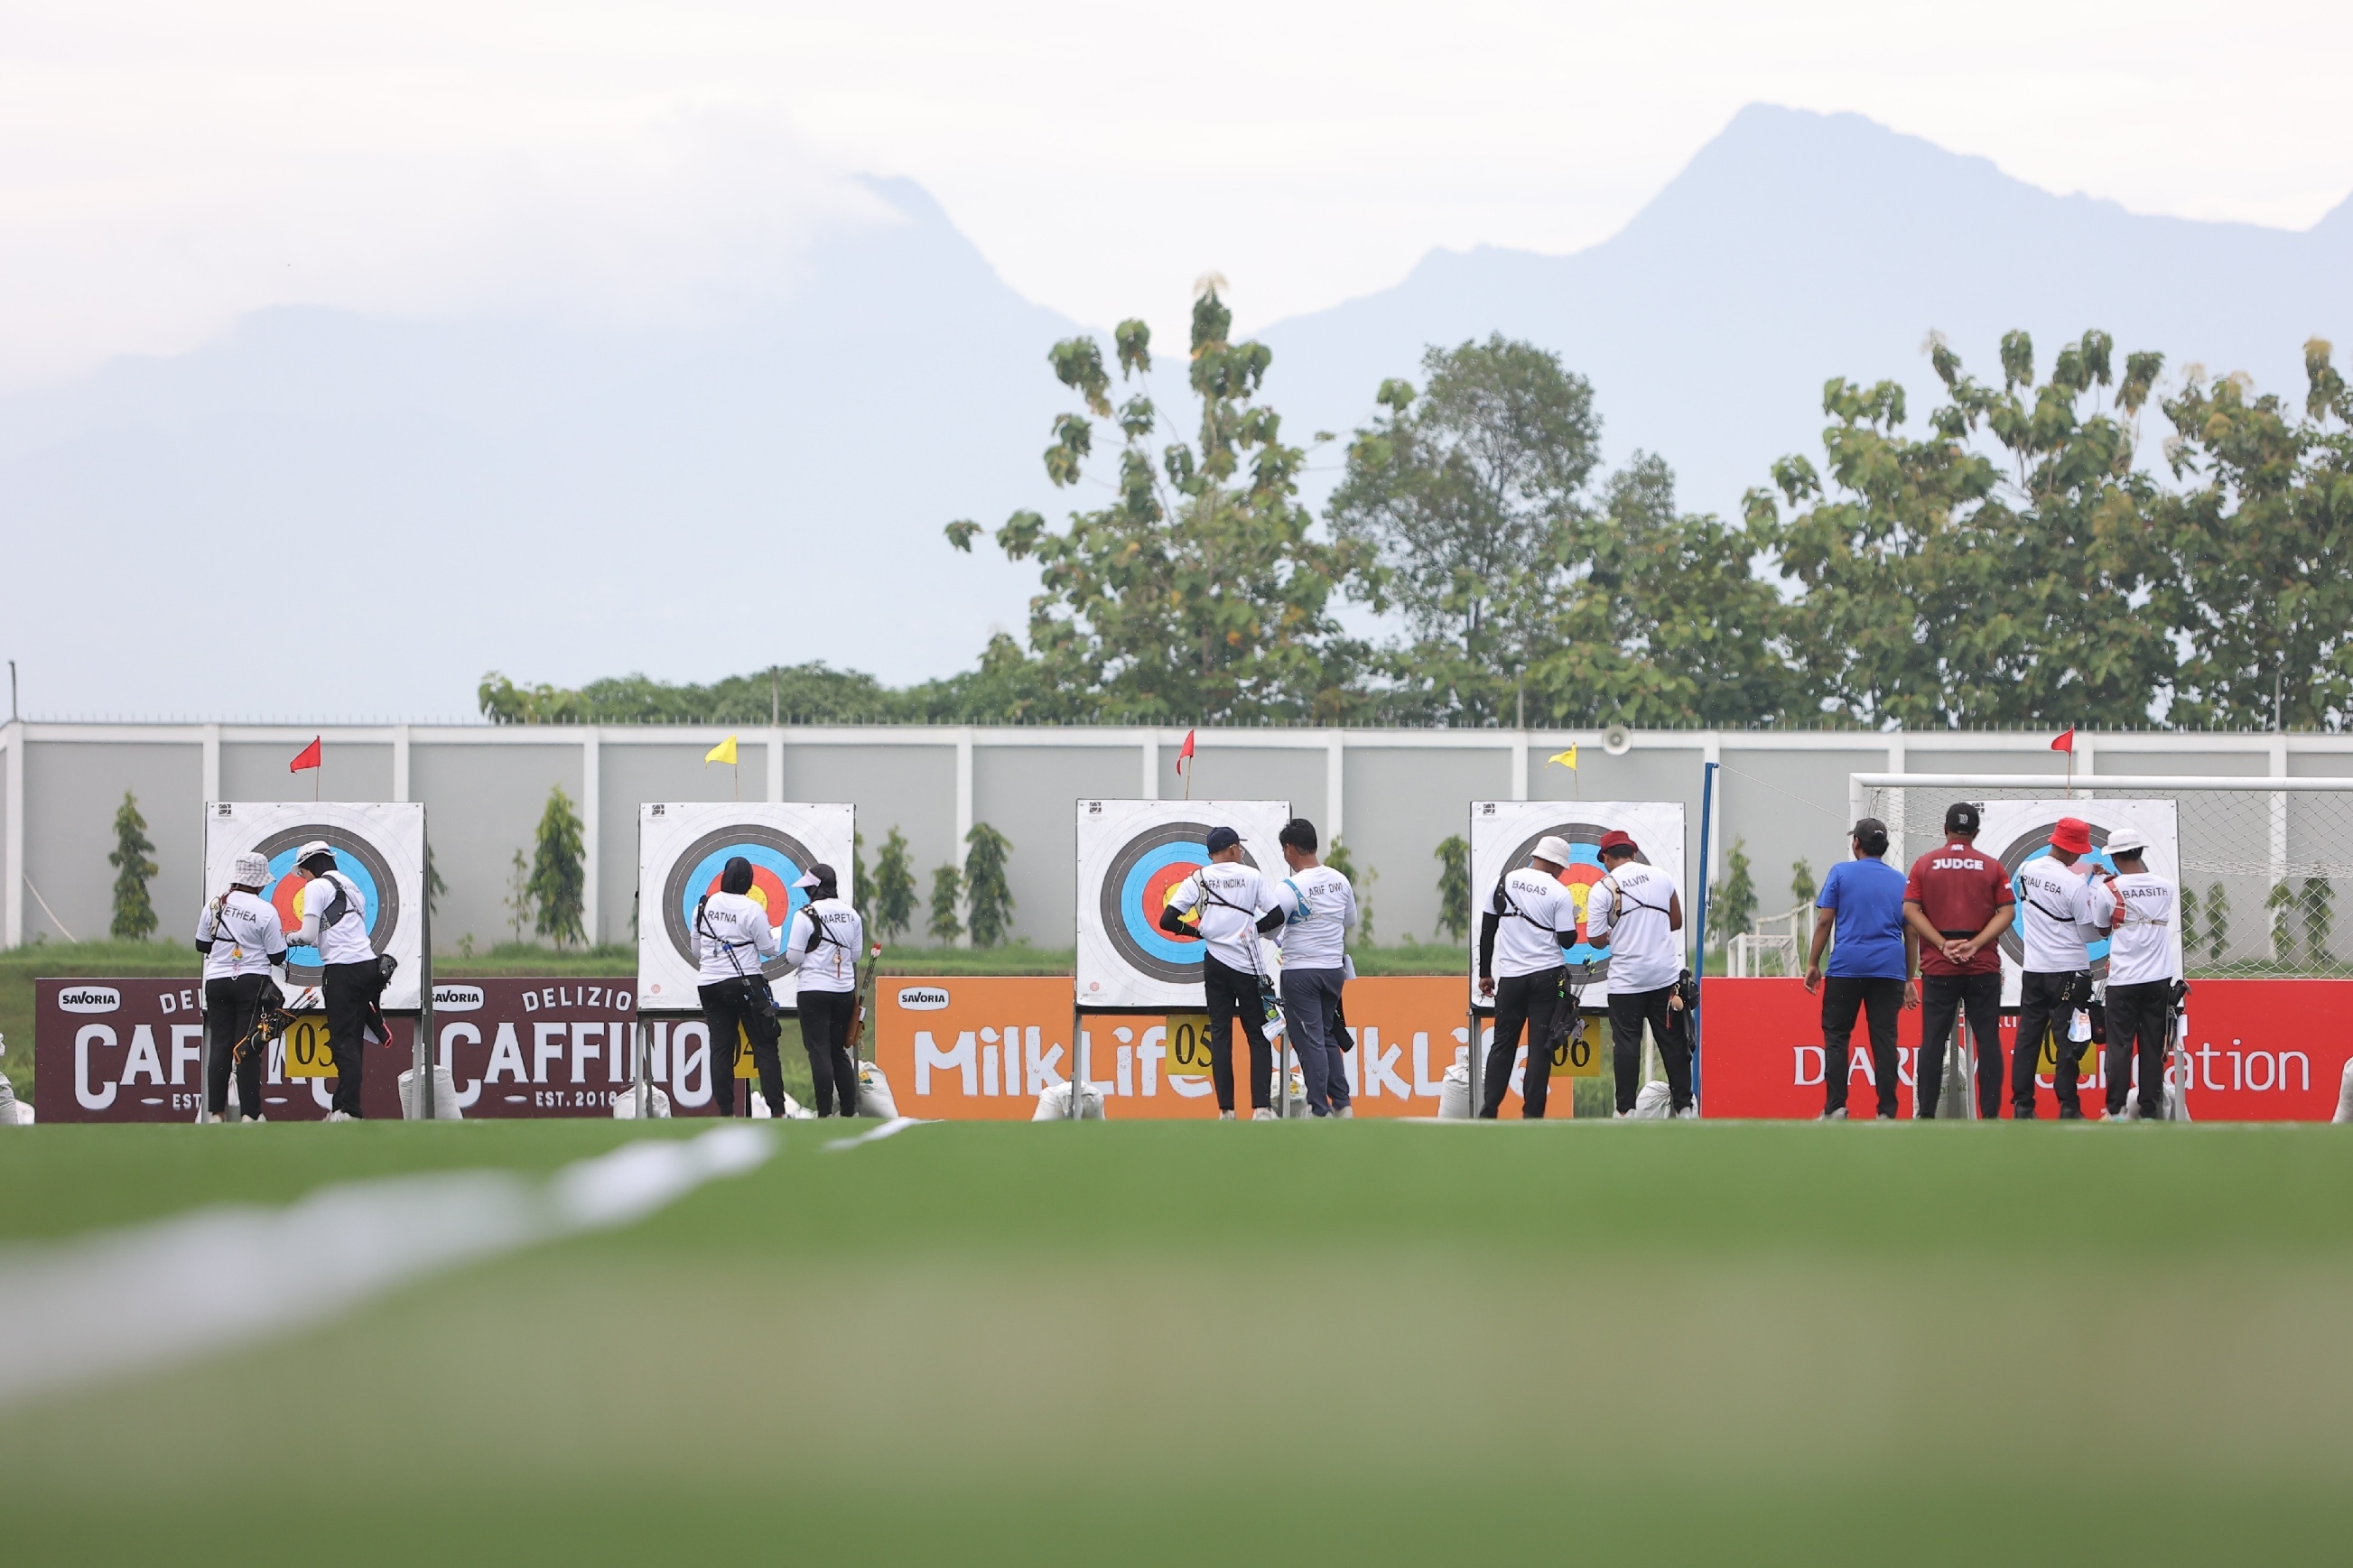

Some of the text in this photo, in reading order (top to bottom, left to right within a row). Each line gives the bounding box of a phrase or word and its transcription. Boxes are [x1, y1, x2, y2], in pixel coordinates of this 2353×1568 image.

[1932, 858, 1984, 870] JUDGE
[1204, 878, 1245, 889] AFFA INDIKA
[1512, 880, 1547, 895] BAGAS
[1622, 874, 1649, 888] ALVIN
[2023, 875, 2061, 895] RIAU EGA
[1309, 882, 1343, 896] ARIF DWI
[2123, 887, 2168, 899] BAASITH
[708, 910, 737, 924] RATNA
[821, 914, 855, 924] MARETA
[62, 991, 116, 1005] SAVORIA
[521, 986, 632, 1013] DELIZIO
[901, 991, 945, 1003] SAVORIA
[1176, 1023, 1213, 1067] 05
[535, 1090, 618, 1107] EST. 2018
